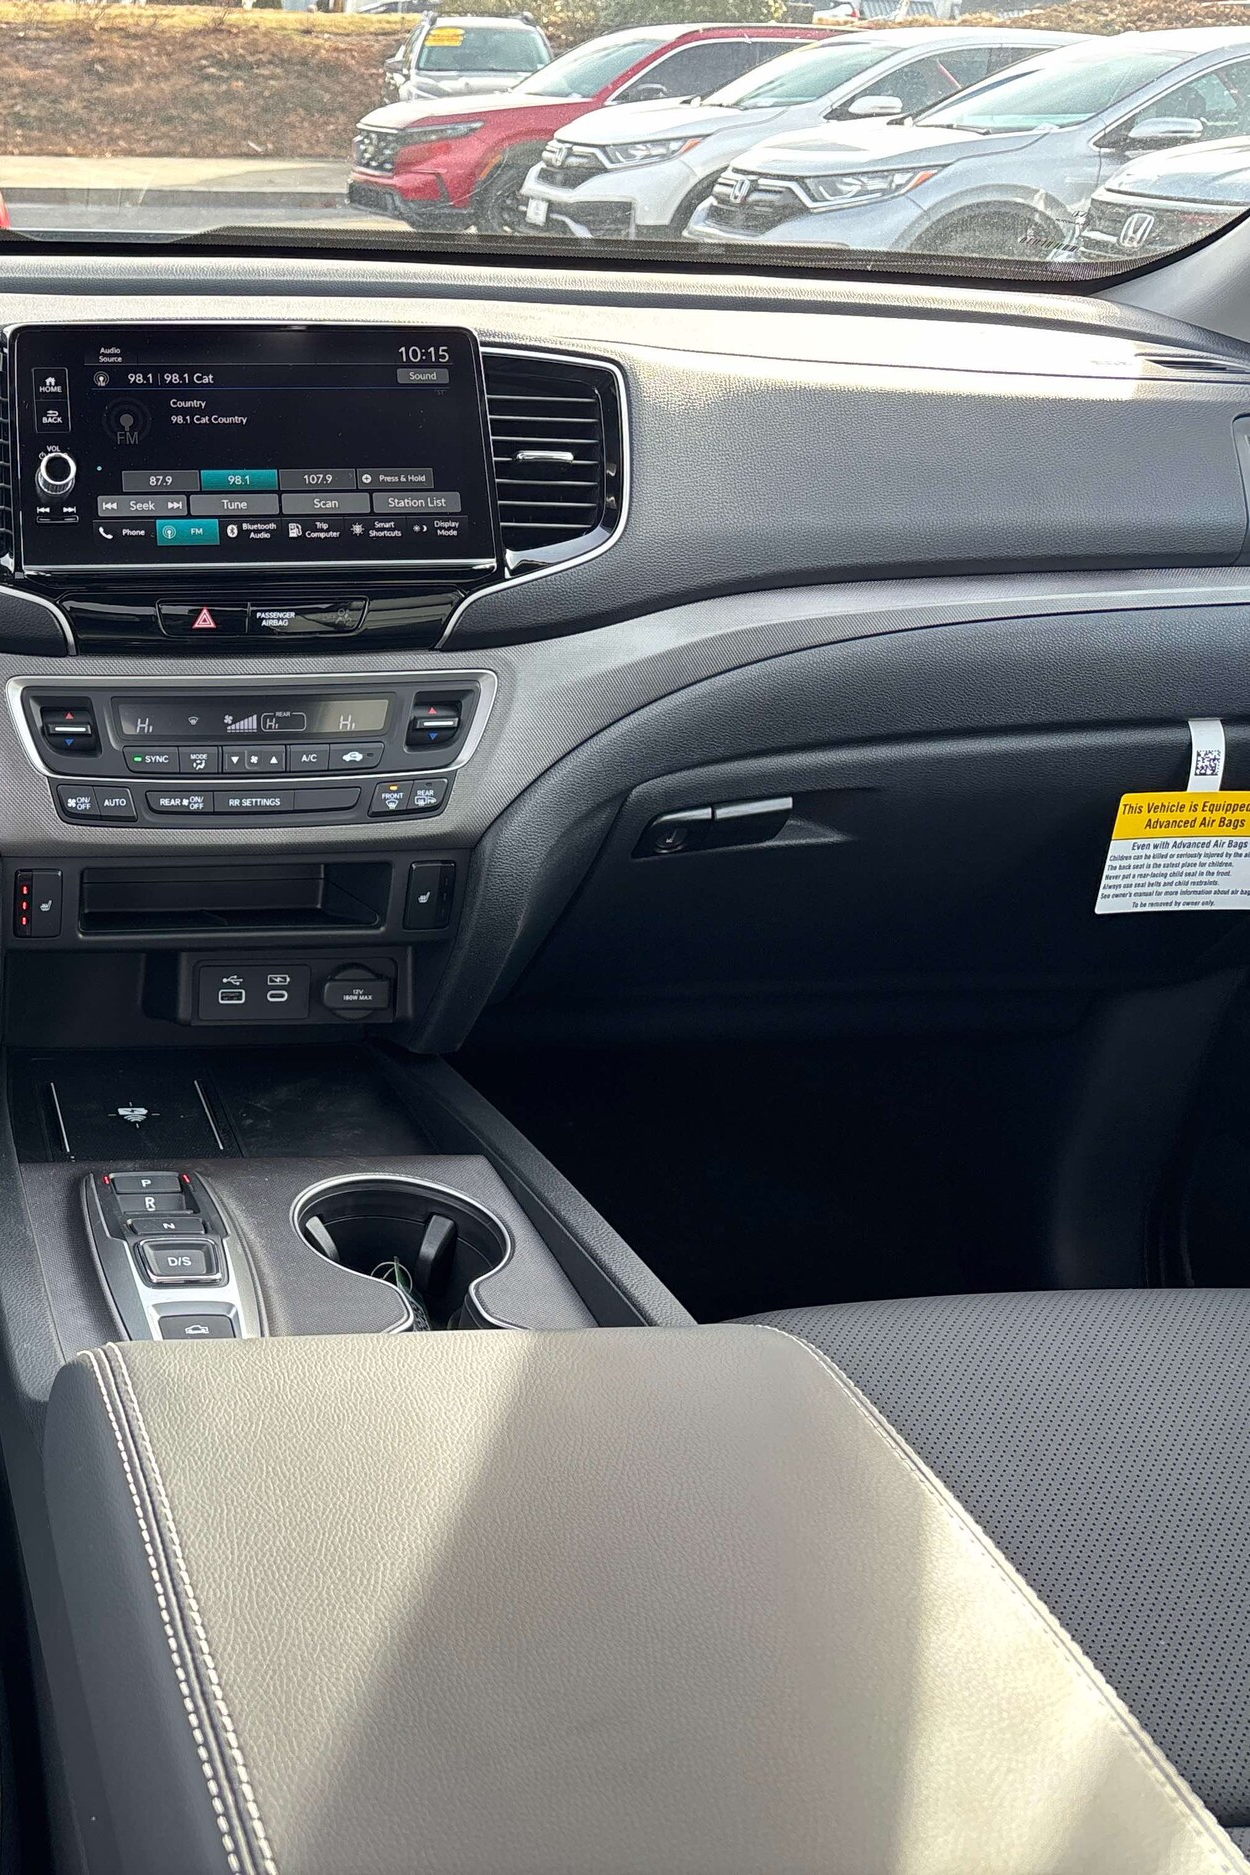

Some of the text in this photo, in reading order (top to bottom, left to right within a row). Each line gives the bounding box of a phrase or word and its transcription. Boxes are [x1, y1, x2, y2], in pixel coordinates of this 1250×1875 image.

[398, 346, 449, 362] 10:15
[128, 373, 214, 384] 98.1 98.1 Cat
[409, 372, 437, 380] Sound
[170, 399, 206, 409] Country
[171, 415, 248, 425] 98.1 Cat Country
[117, 431, 139, 445] FM
[149, 476, 172, 486] 87.9
[228, 475, 250, 485] 98.1
[303, 475, 332, 484] 107.9
[130, 501, 155, 511] Seek
[222, 500, 247, 510] Tune
[314, 499, 338, 508] Scan
[388, 498, 446, 507] Station List
[315, 522, 329, 530] Trip
[434, 521, 459, 529] Display
[122, 529, 146, 537] Phone
[306, 531, 340, 539] Computer
[301, 754, 317, 762] A/C
[382, 792, 404, 800] FRONT
[241, 798, 280, 806] SETTINGS
[1122, 803, 1143, 815] This
[1147, 801, 1186, 814] Vehicle
[1188, 801, 1198, 812] is
[1144, 816, 1246, 830] Advanced Air Bags
[1132, 840, 1248, 850] Even with Advanced Air Bags
[145, 1197, 156, 1211] R
[168, 1257, 192, 1266] D/S
